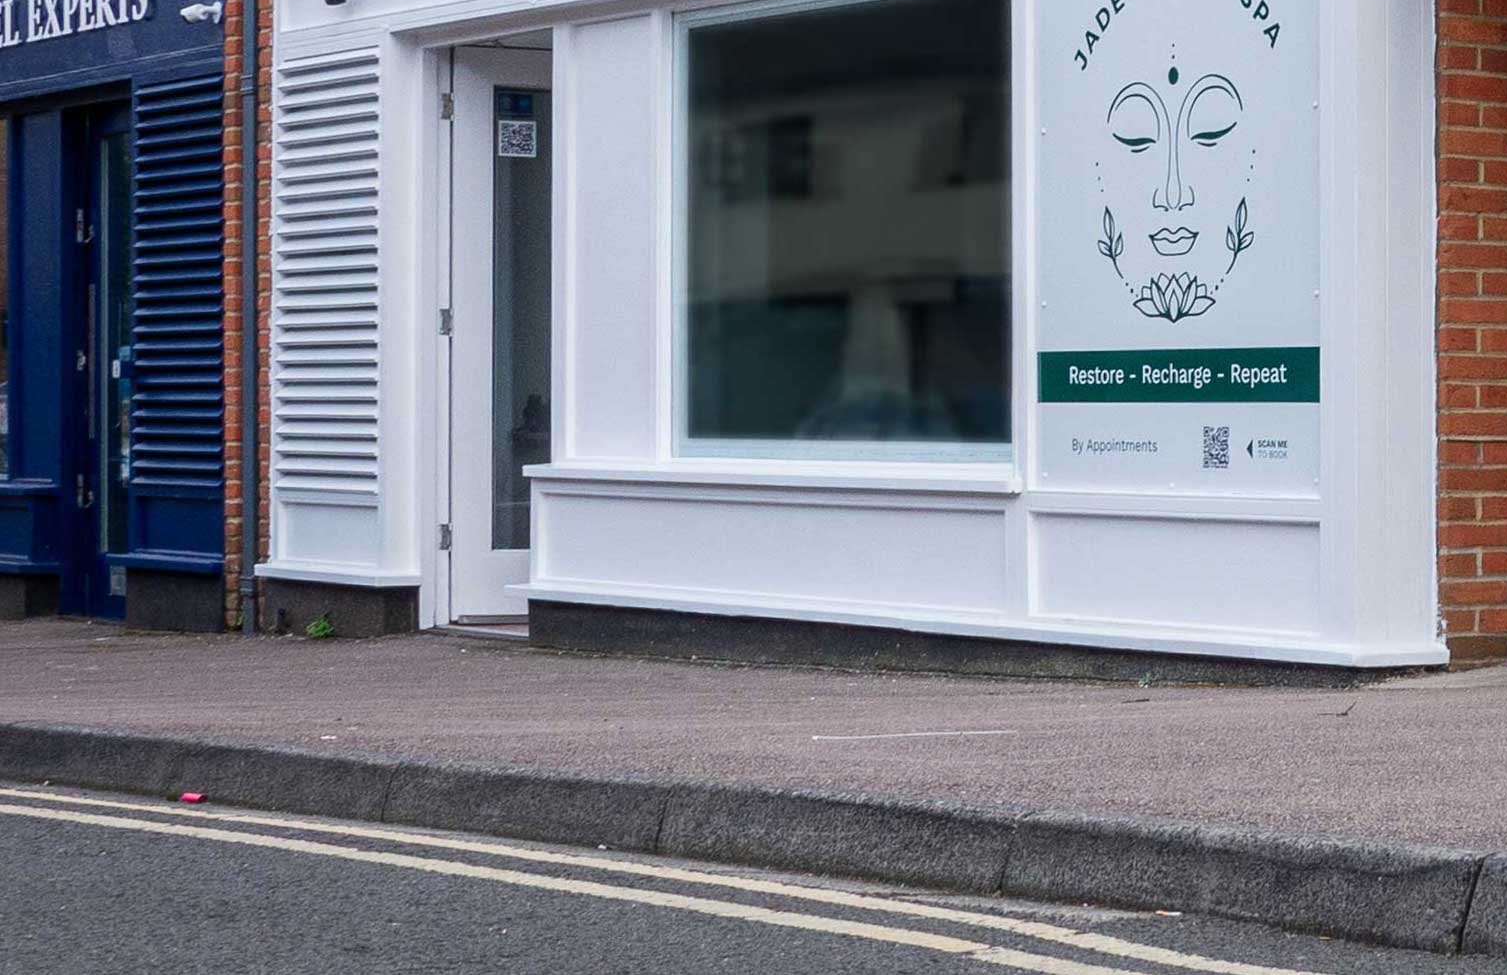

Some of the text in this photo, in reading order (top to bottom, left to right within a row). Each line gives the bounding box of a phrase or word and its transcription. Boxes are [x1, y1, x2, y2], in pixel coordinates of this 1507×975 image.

[1068, 365, 1125, 385] Restore
[1142, 363, 1212, 389] Recharge
[1230, 363, 1288, 388] Repeat
[1071, 438, 1158, 455] By Appointments
[1257, 439, 1288, 449] SCAN ME
